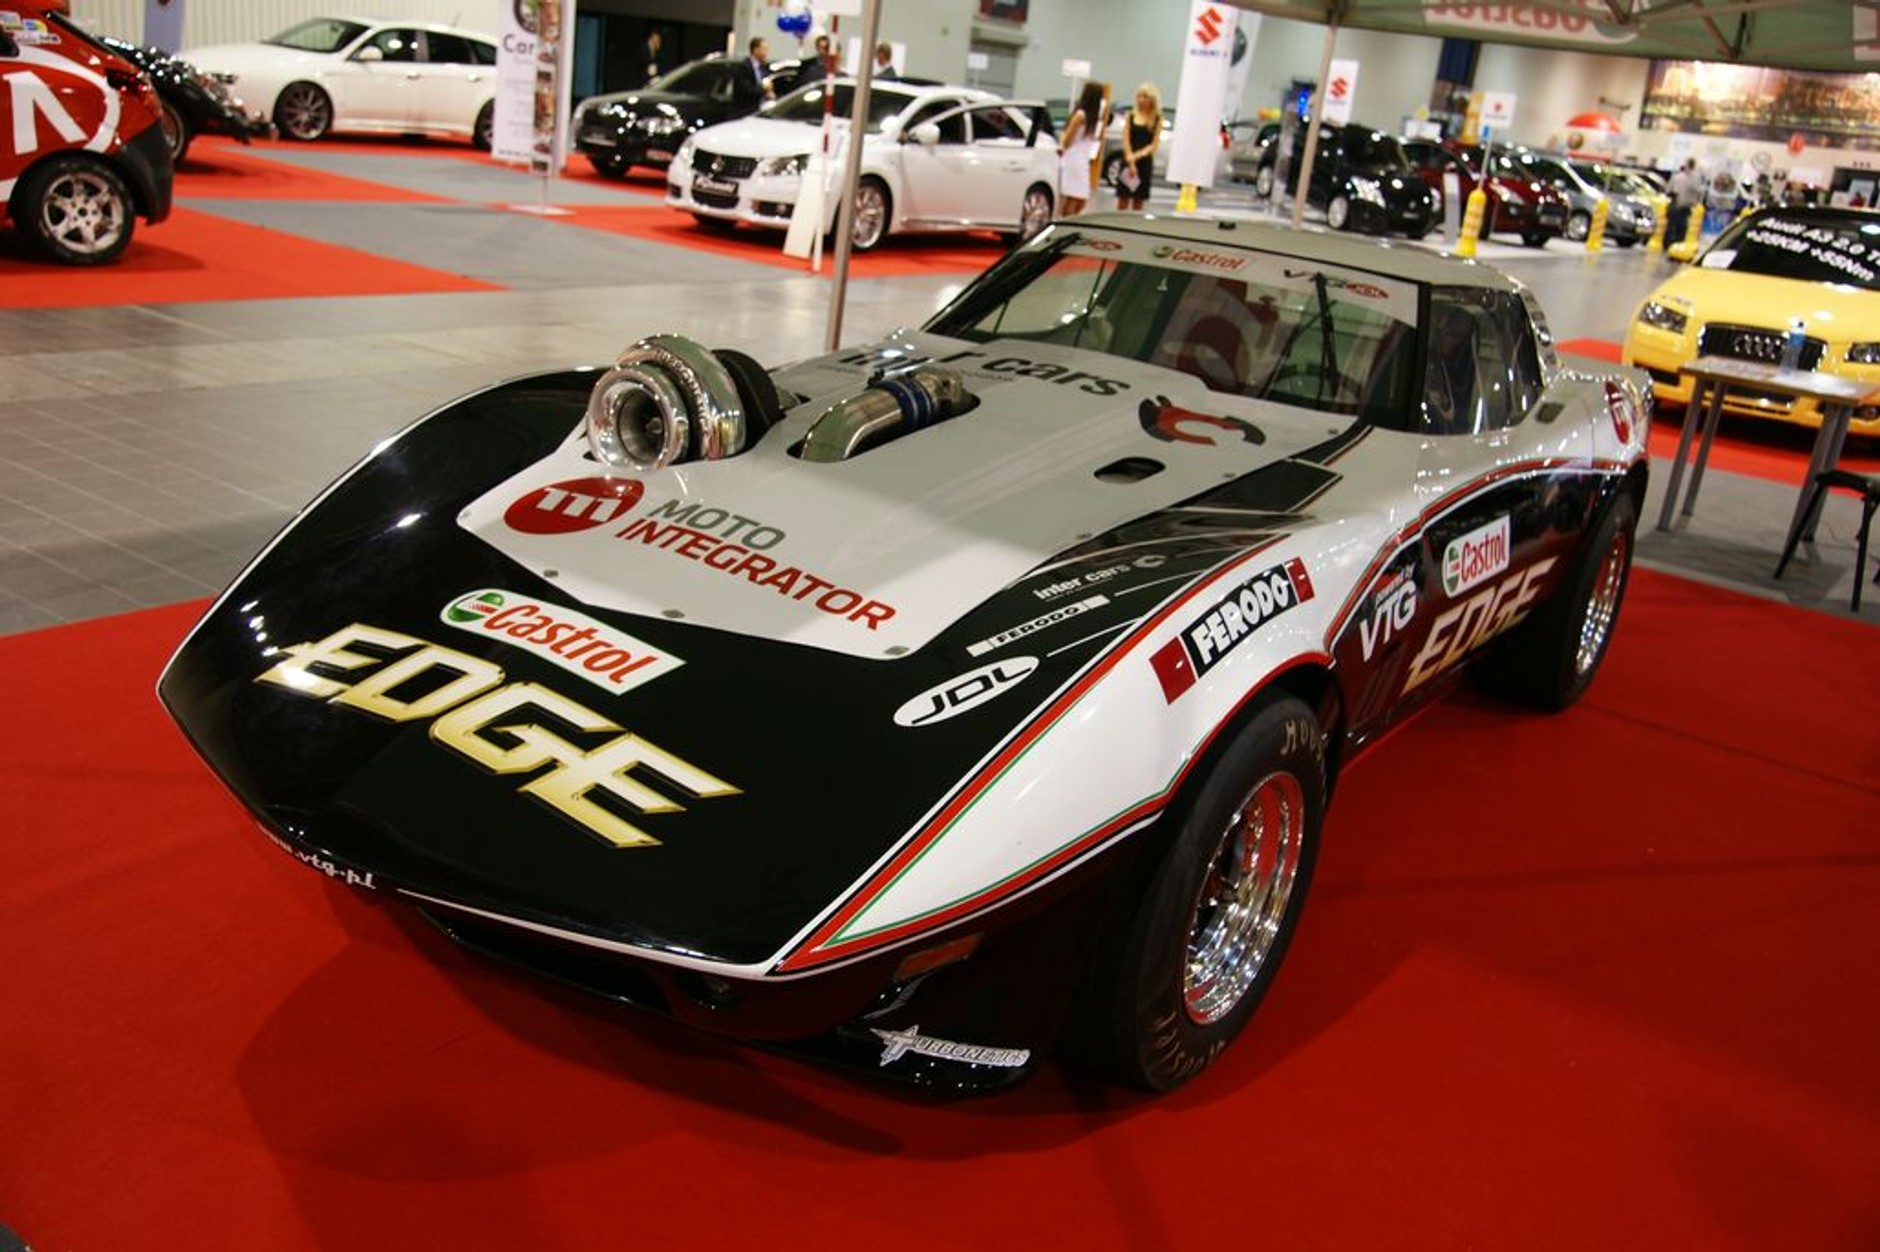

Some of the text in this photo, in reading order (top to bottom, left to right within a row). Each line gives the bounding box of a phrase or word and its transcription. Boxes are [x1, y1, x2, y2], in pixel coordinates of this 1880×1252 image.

[1172, 249, 1245, 270] Castrol
[982, 357, 1131, 396] cars
[647, 499, 786, 551] MOTO
[1460, 526, 1507, 584] Castrol
[614, 518, 897, 631] INTEGRATOR
[483, 603, 658, 685] Castrol
[997, 606, 1080, 643] FERODO
[1191, 570, 1290, 666] FERODO
[1360, 579, 1417, 662] VTG
[1401, 555, 1560, 695] EDGE
[911, 666, 1032, 724] JDL
[253, 622, 745, 849] EDGE
